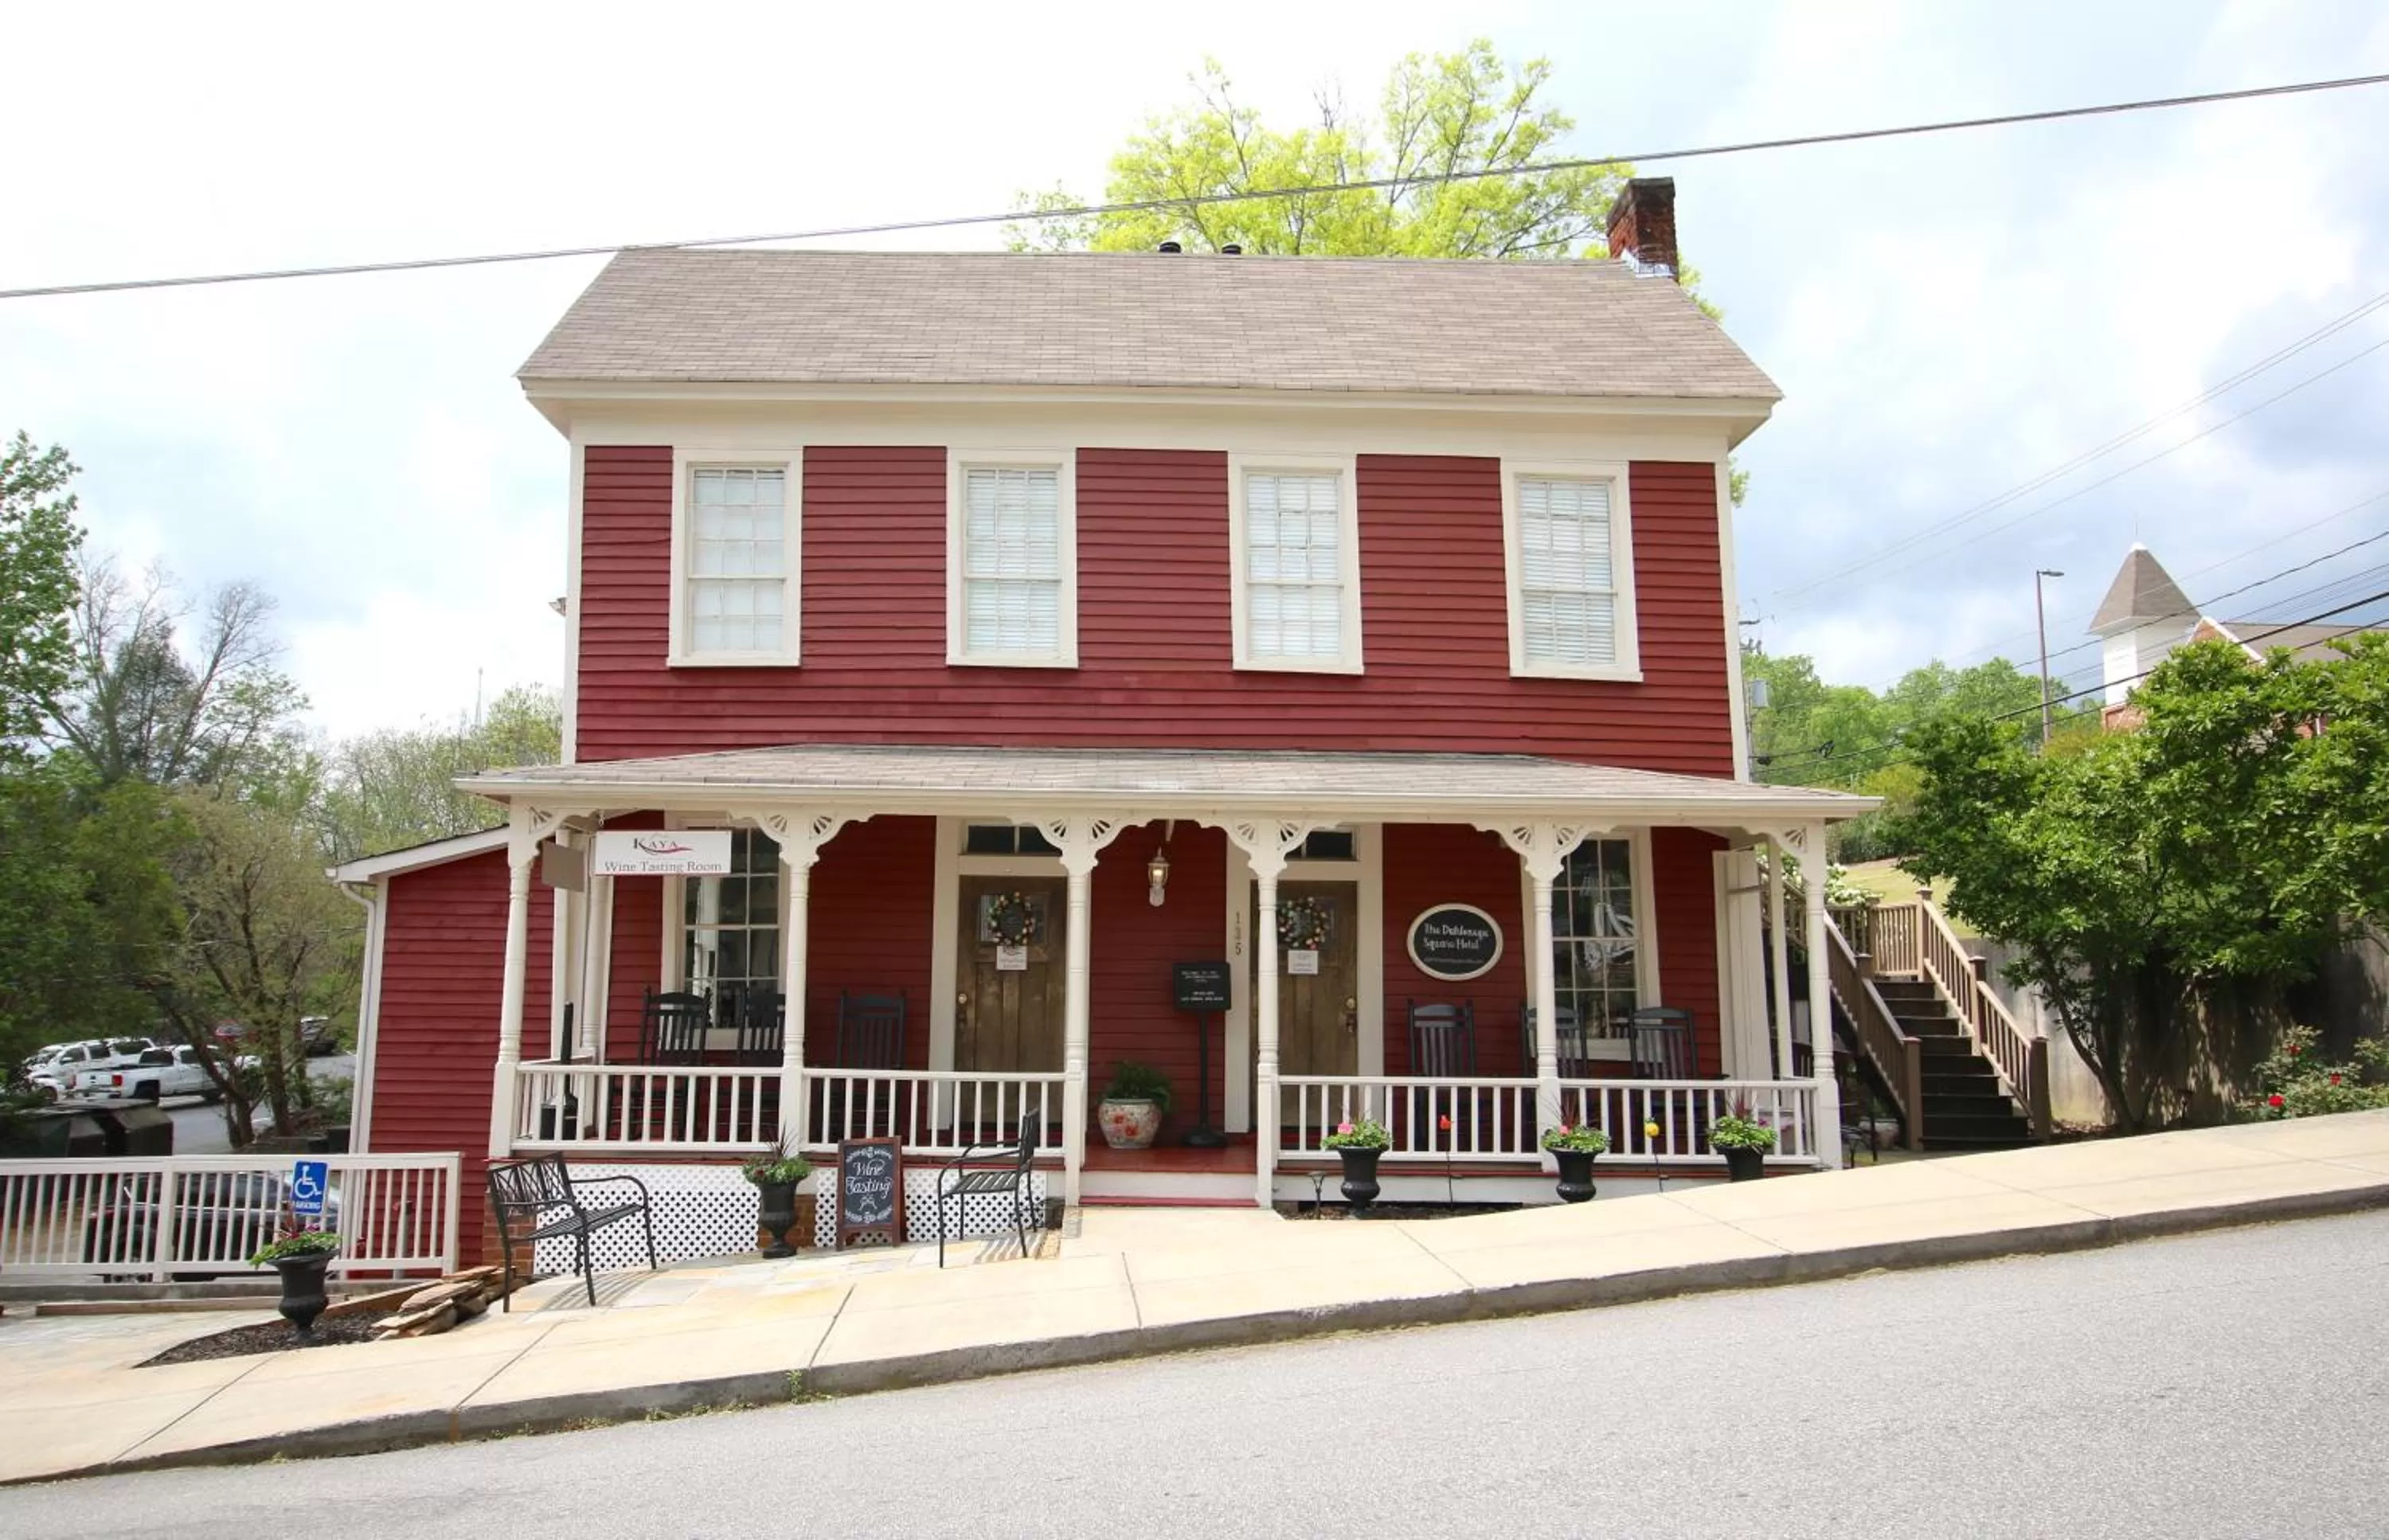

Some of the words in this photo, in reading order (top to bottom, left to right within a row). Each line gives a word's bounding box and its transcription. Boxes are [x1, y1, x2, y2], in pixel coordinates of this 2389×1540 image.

[633, 838, 680, 852] KAYA
[604, 861, 636, 872] Wine
[640, 861, 683, 874] Tasting
[686, 861, 722, 872] Room
[1424, 924, 1441, 934] The
[1423, 937, 1455, 951] Square
[1456, 938, 1480, 949] Hotel
[853, 1159, 886, 1176] Wine
[846, 1176, 893, 1199] Tasting
